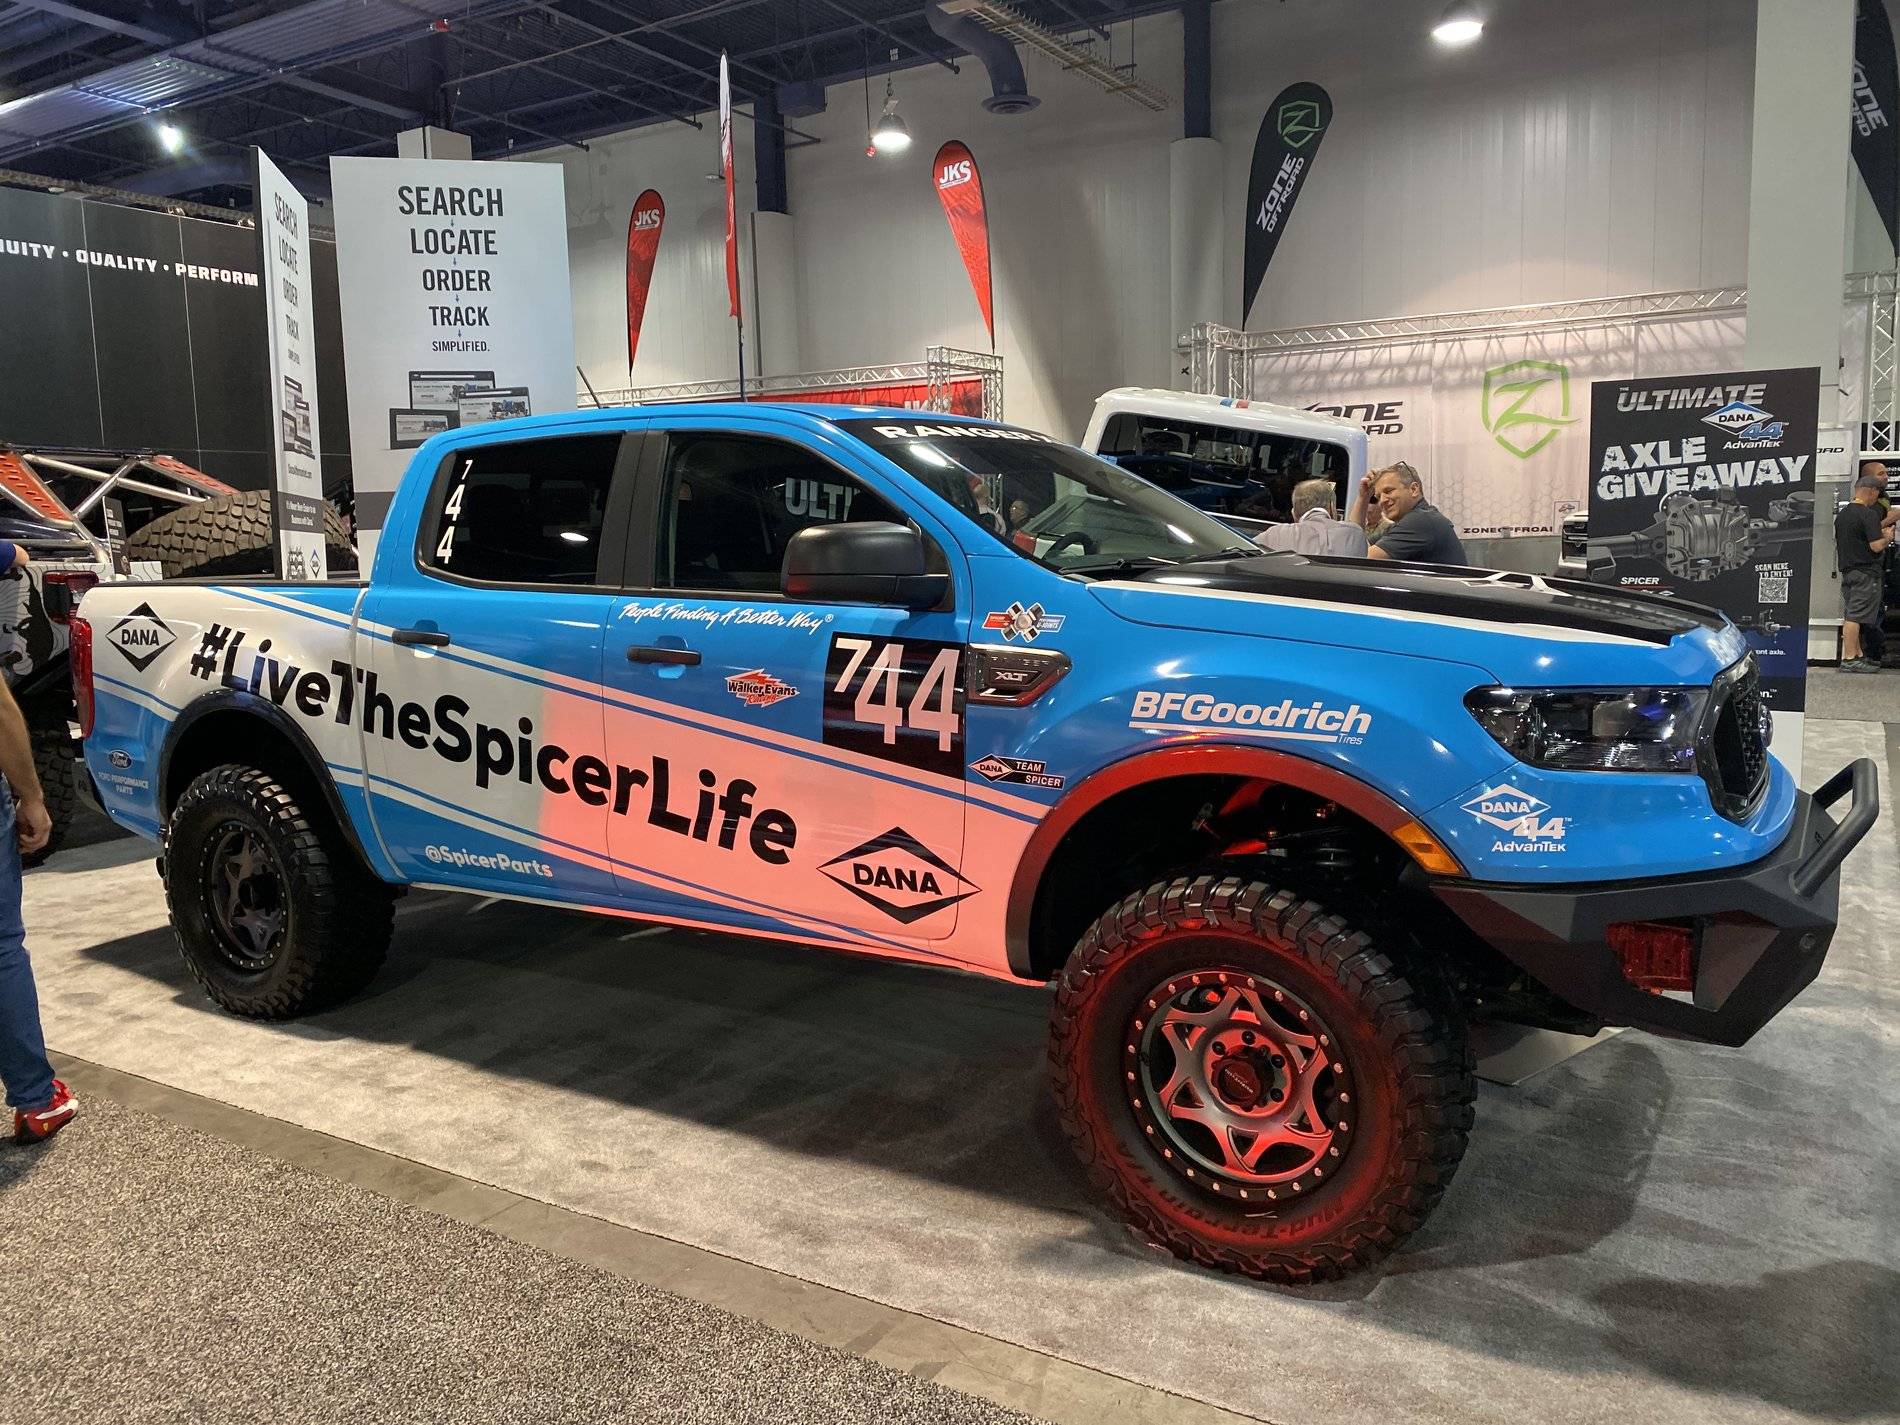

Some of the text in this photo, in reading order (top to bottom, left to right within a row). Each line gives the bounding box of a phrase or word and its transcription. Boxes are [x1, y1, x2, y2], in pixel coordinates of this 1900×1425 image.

[1853, 59, 1889, 130] ONE
[939, 160, 971, 184] JKS
[398, 185, 504, 217] SEARCH
[1256, 153, 1296, 231] ZONE
[634, 209, 660, 228] JKS
[410, 228, 498, 255] LOCATE
[76, 249, 157, 273] QUALITY
[175, 262, 259, 287] PERFORM
[422, 268, 491, 292] ORDER
[429, 306, 489, 326] TRACK
[432, 341, 490, 352] SIMPLIFIED.
[1616, 383, 1768, 412] ULTIMATE
[1303, 401, 1403, 422] ONE
[1718, 413, 1755, 423] DANA
[1601, 436, 1707, 472] AXLE
[1597, 455, 1810, 500] GIVEAWAY
[1755, 563, 1772, 571] SCAN
[1620, 576, 1660, 585] SPICER
[618, 602, 662, 624] People
[661, 603, 719, 630] Finding
[719, 607, 737, 626] A
[733, 607, 787, 628] Better
[120, 628, 161, 646] DANA
[728, 681, 796, 696] Walker Evans
[995, 671, 1028, 682] XLT
[833, 637, 961, 752] 744
[1131, 690, 1372, 735] BFGoodrich
[189, 622, 798, 866] #LiveTheSpicerLife
[1336, 732, 1364, 746] Tires
[980, 761, 1042, 773] DANA TEAM
[1025, 775, 1061, 787] SPICER
[1481, 801, 1531, 813] DANA
[424, 843, 553, 879] @SpicerParts
[852, 862, 943, 896] DANA
